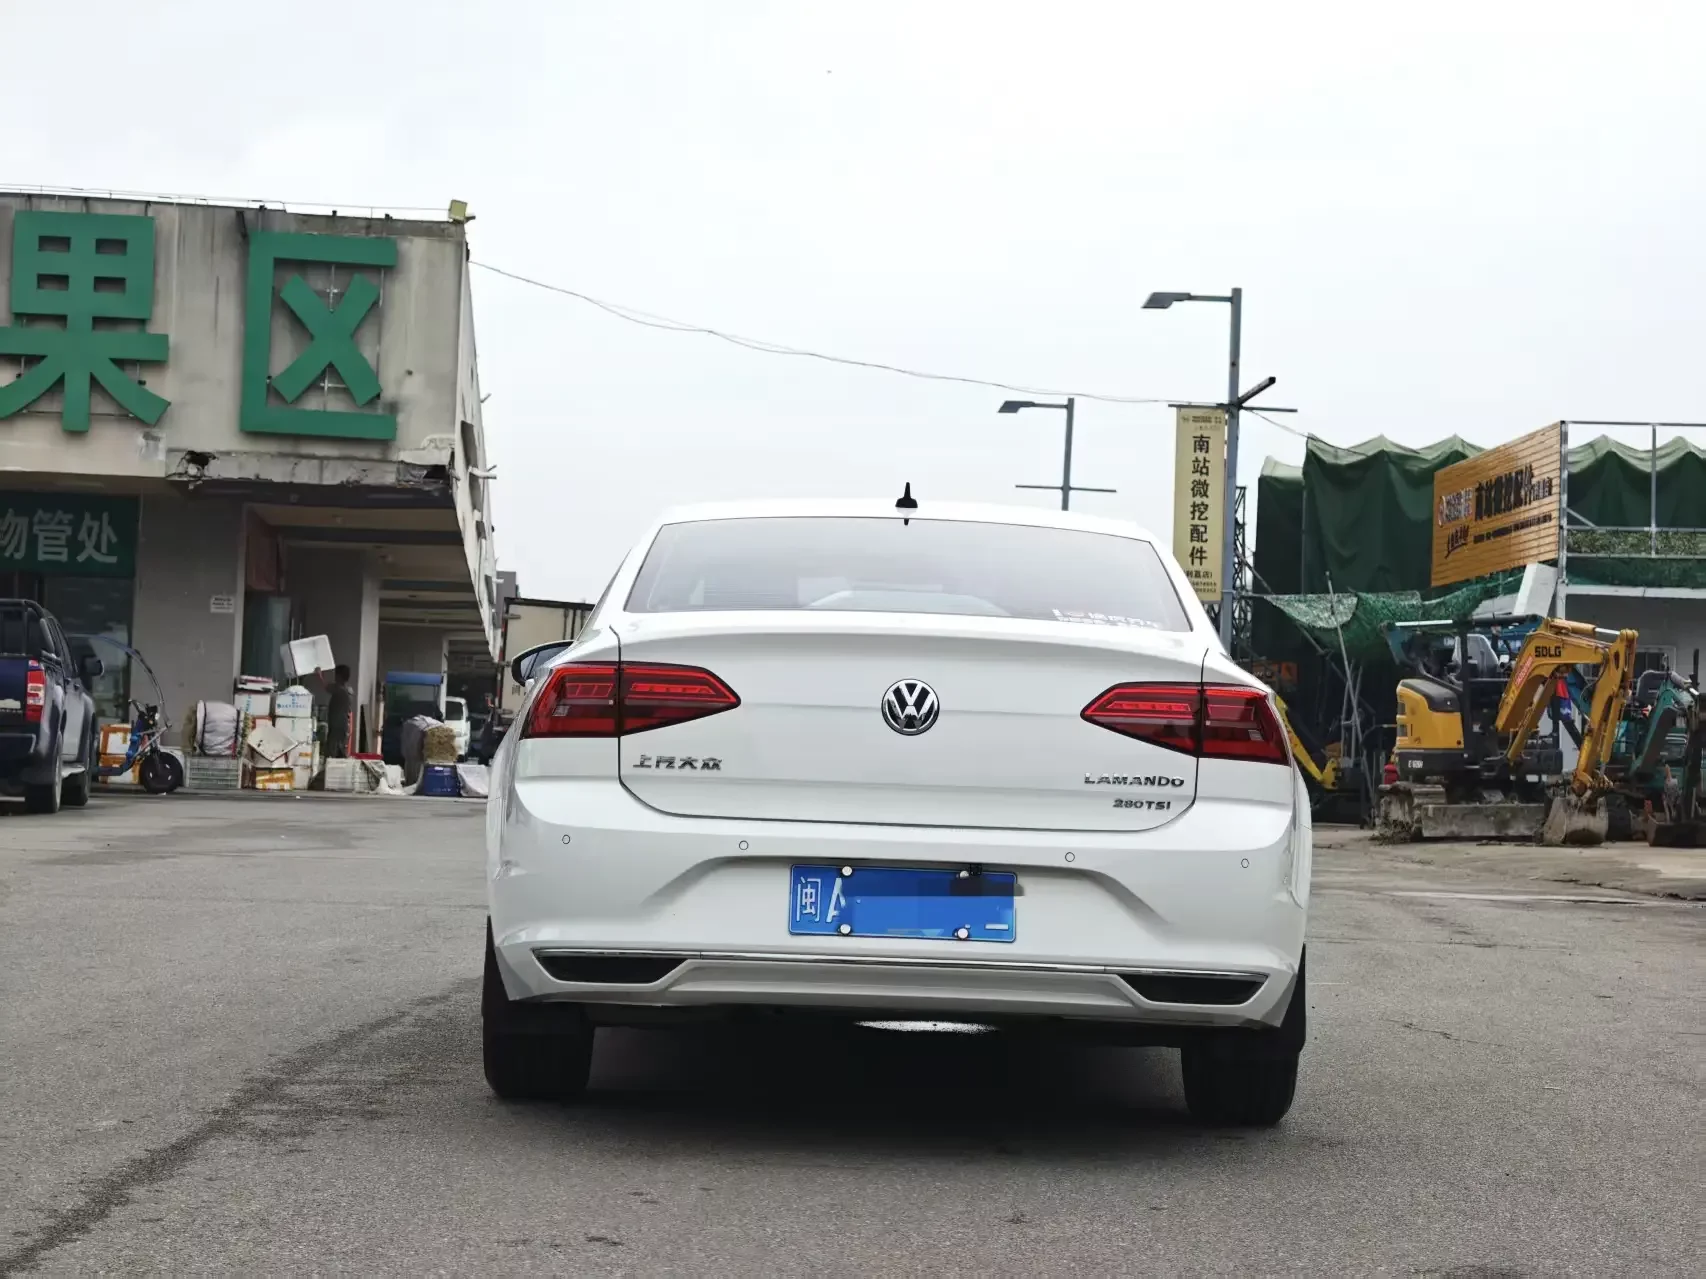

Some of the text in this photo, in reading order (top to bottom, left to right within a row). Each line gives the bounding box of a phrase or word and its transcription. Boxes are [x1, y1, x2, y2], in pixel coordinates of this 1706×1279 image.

[0, 210, 397, 441] 果区
[1189, 433, 1211, 566] 南站微挖配件
[1534, 645, 1562, 658] SDLG
[632, 754, 723, 771] 上汽大众
[1083, 773, 1185, 787] LAMANDO
[1112, 798, 1171, 810] 280TSI
